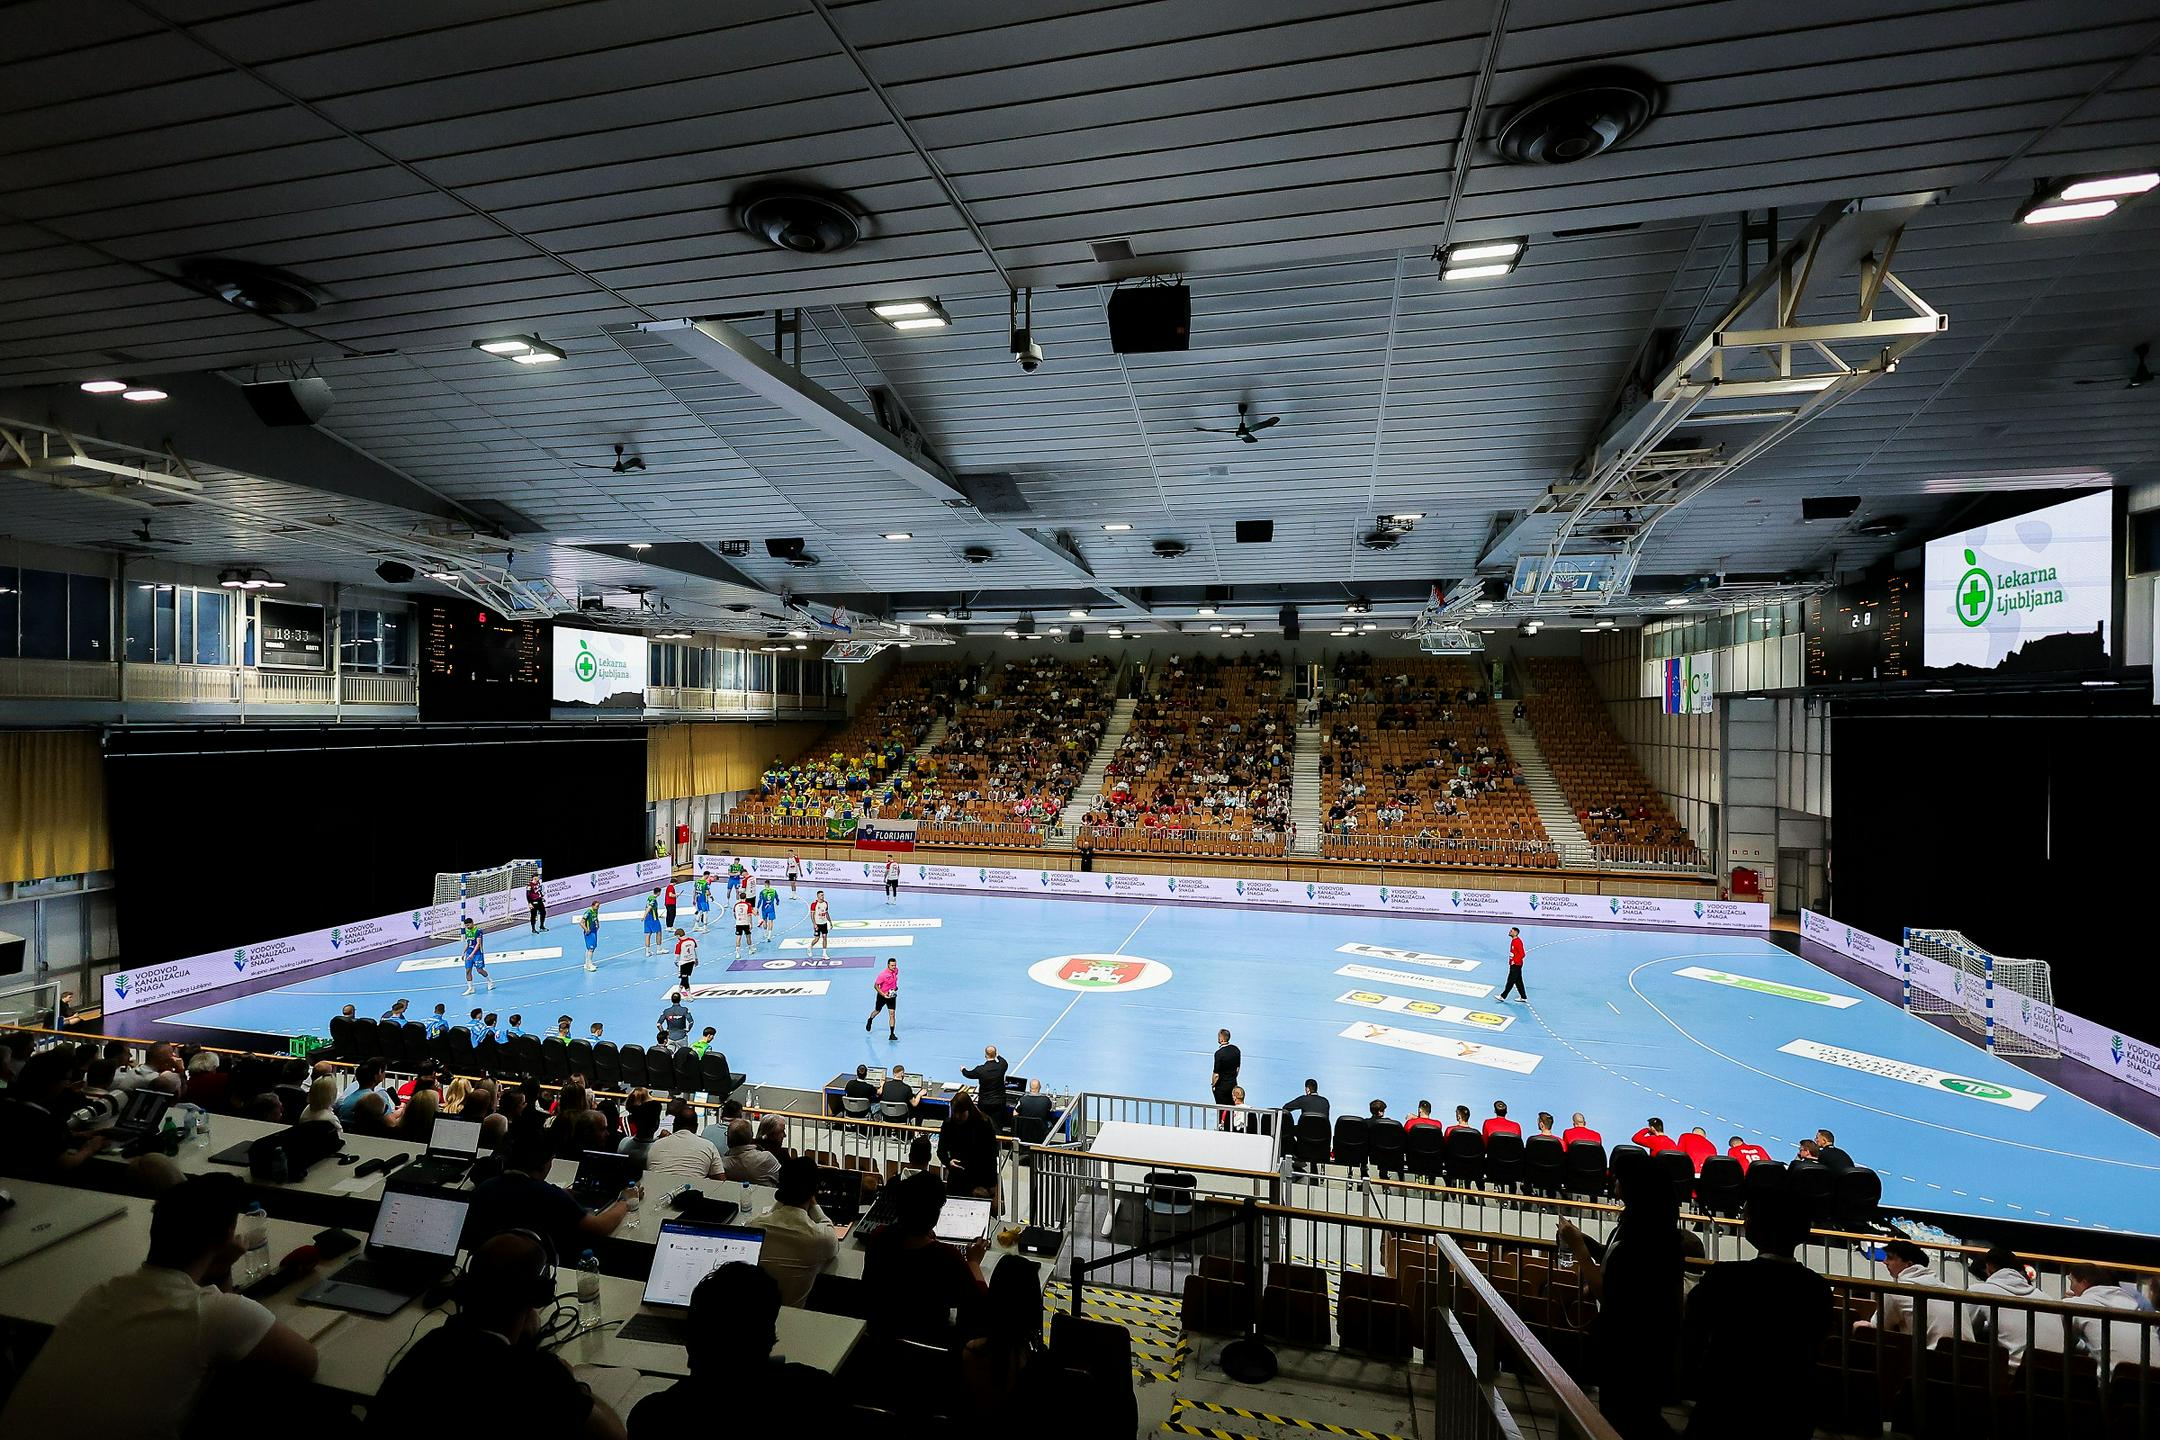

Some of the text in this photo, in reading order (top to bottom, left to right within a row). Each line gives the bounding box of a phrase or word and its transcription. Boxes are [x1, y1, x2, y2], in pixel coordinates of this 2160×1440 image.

[1997, 567, 2056, 590] Lekarna
[1997, 589, 2063, 616] Ljubljana
[599, 659, 626, 668] Lekarna
[599, 669, 629, 680] Ljubljana
[345, 923, 374, 933] VODOVOD
[345, 927, 383, 939] KANALIZACIJA
[345, 937, 365, 945] SNAGA
[250, 942, 285, 954] VODOVOD
[250, 946, 295, 960] KANALIZACIJA
[251, 958, 275, 967] SNAGA
[135, 966, 178, 979] VODOVOD
[135, 970, 190, 986] KANALIZACIJA
[135, 983, 164, 994] SNAGA
[172, 987, 189, 996] holding
[2034, 1006, 2064, 1022] VODOOD
[2034, 1014, 2073, 1034] KANALIACIJA
[2034, 1021, 2053, 1034] SNAGA
[2127, 1060, 2152, 1076] SNAGA
